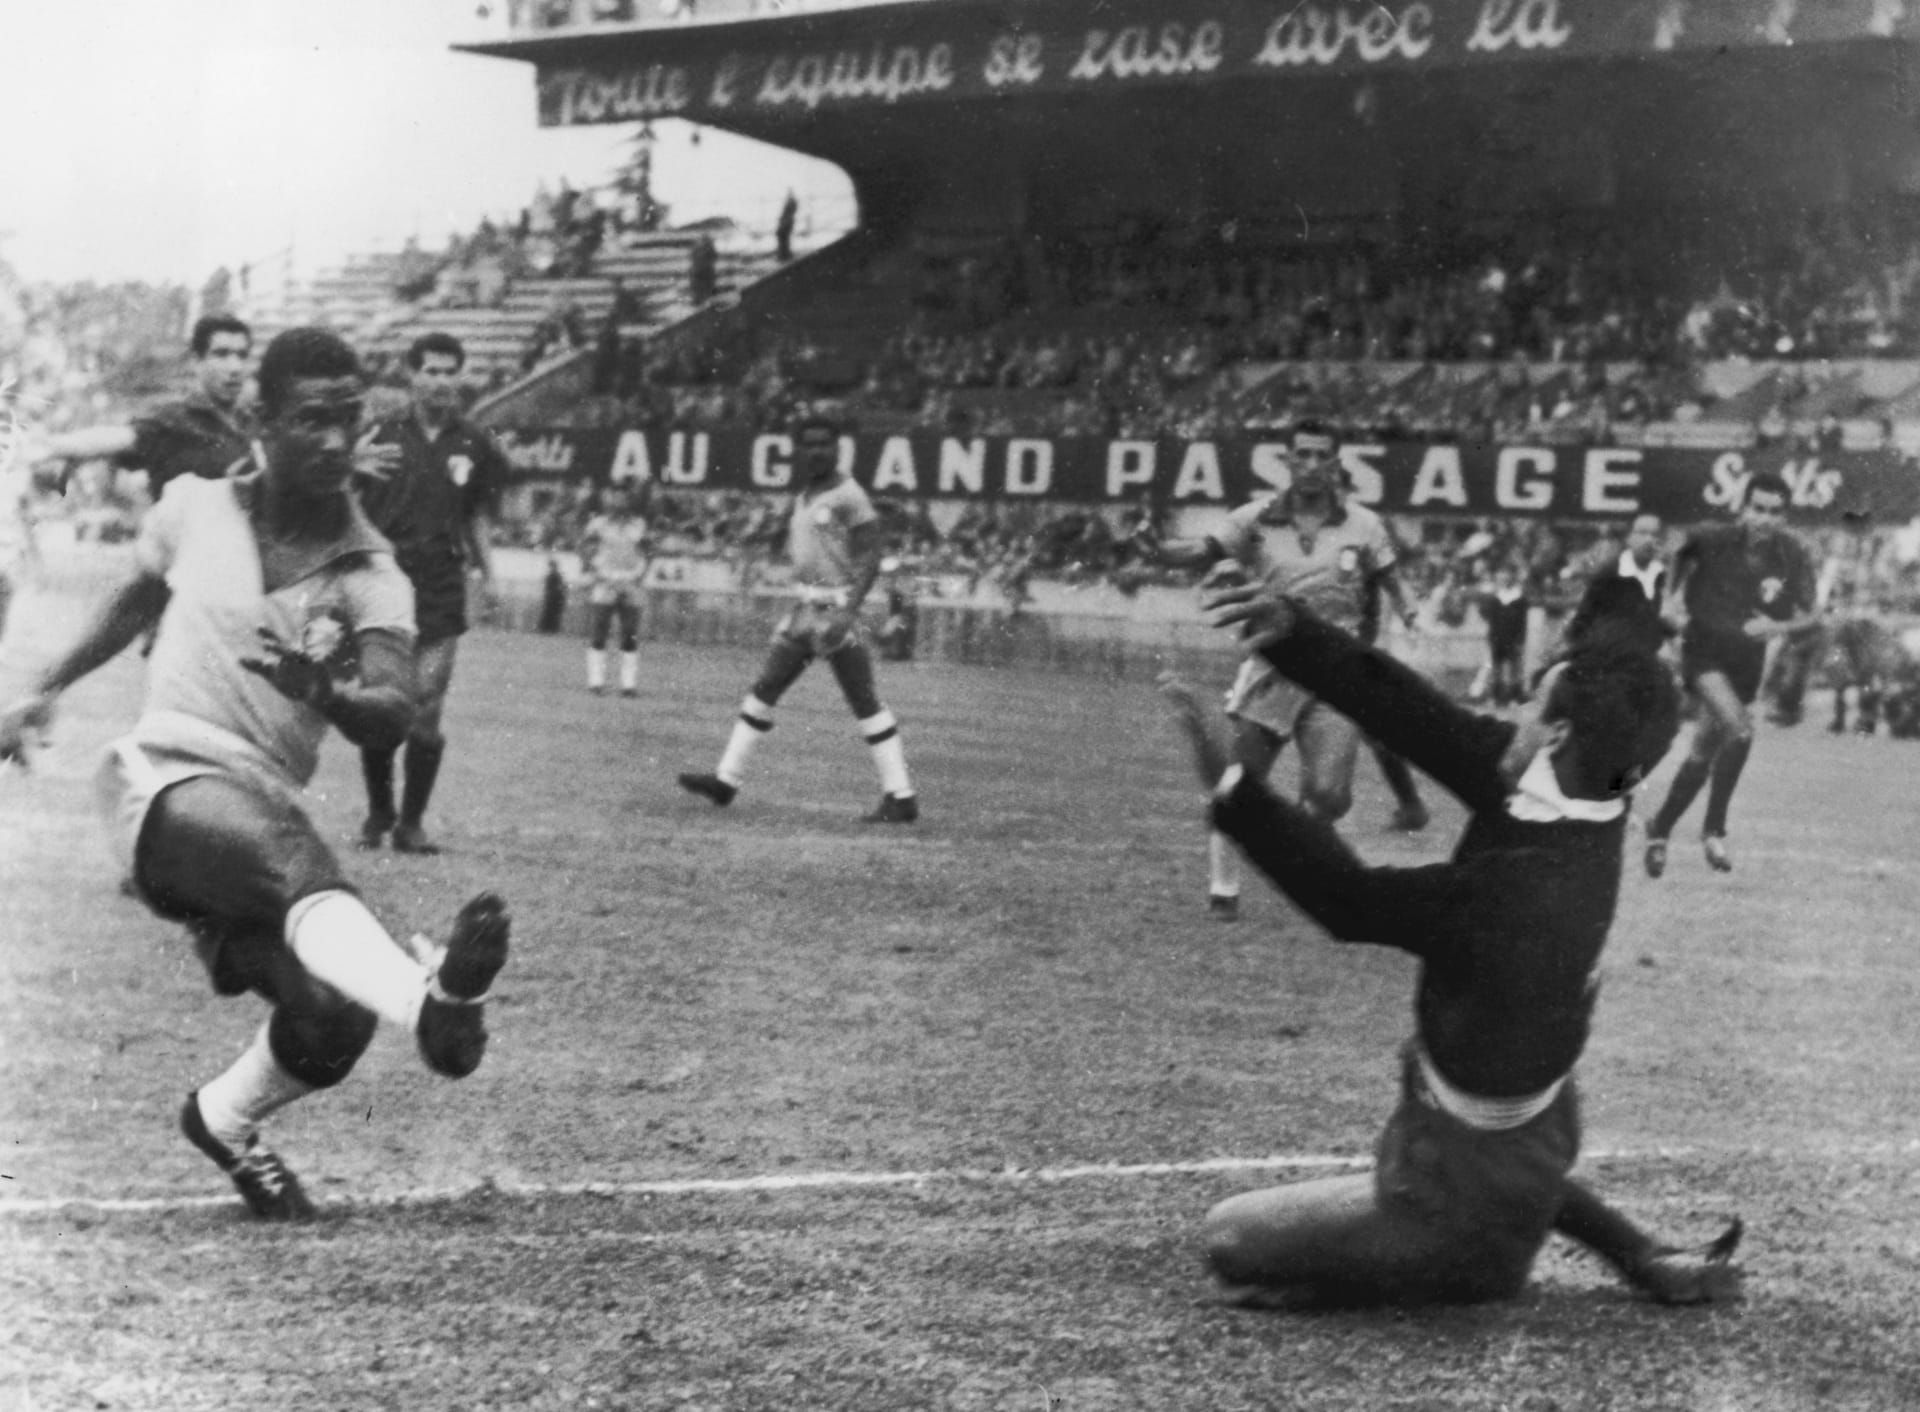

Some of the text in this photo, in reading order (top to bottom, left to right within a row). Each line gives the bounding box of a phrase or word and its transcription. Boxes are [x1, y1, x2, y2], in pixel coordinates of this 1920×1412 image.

[984, 33, 1044, 87] se
[1068, 20, 1224, 80] rase
[1252, 2, 1435, 66] avec
[610, 430, 709, 484] AU
[1106, 440, 1643, 512] PASSAGE
